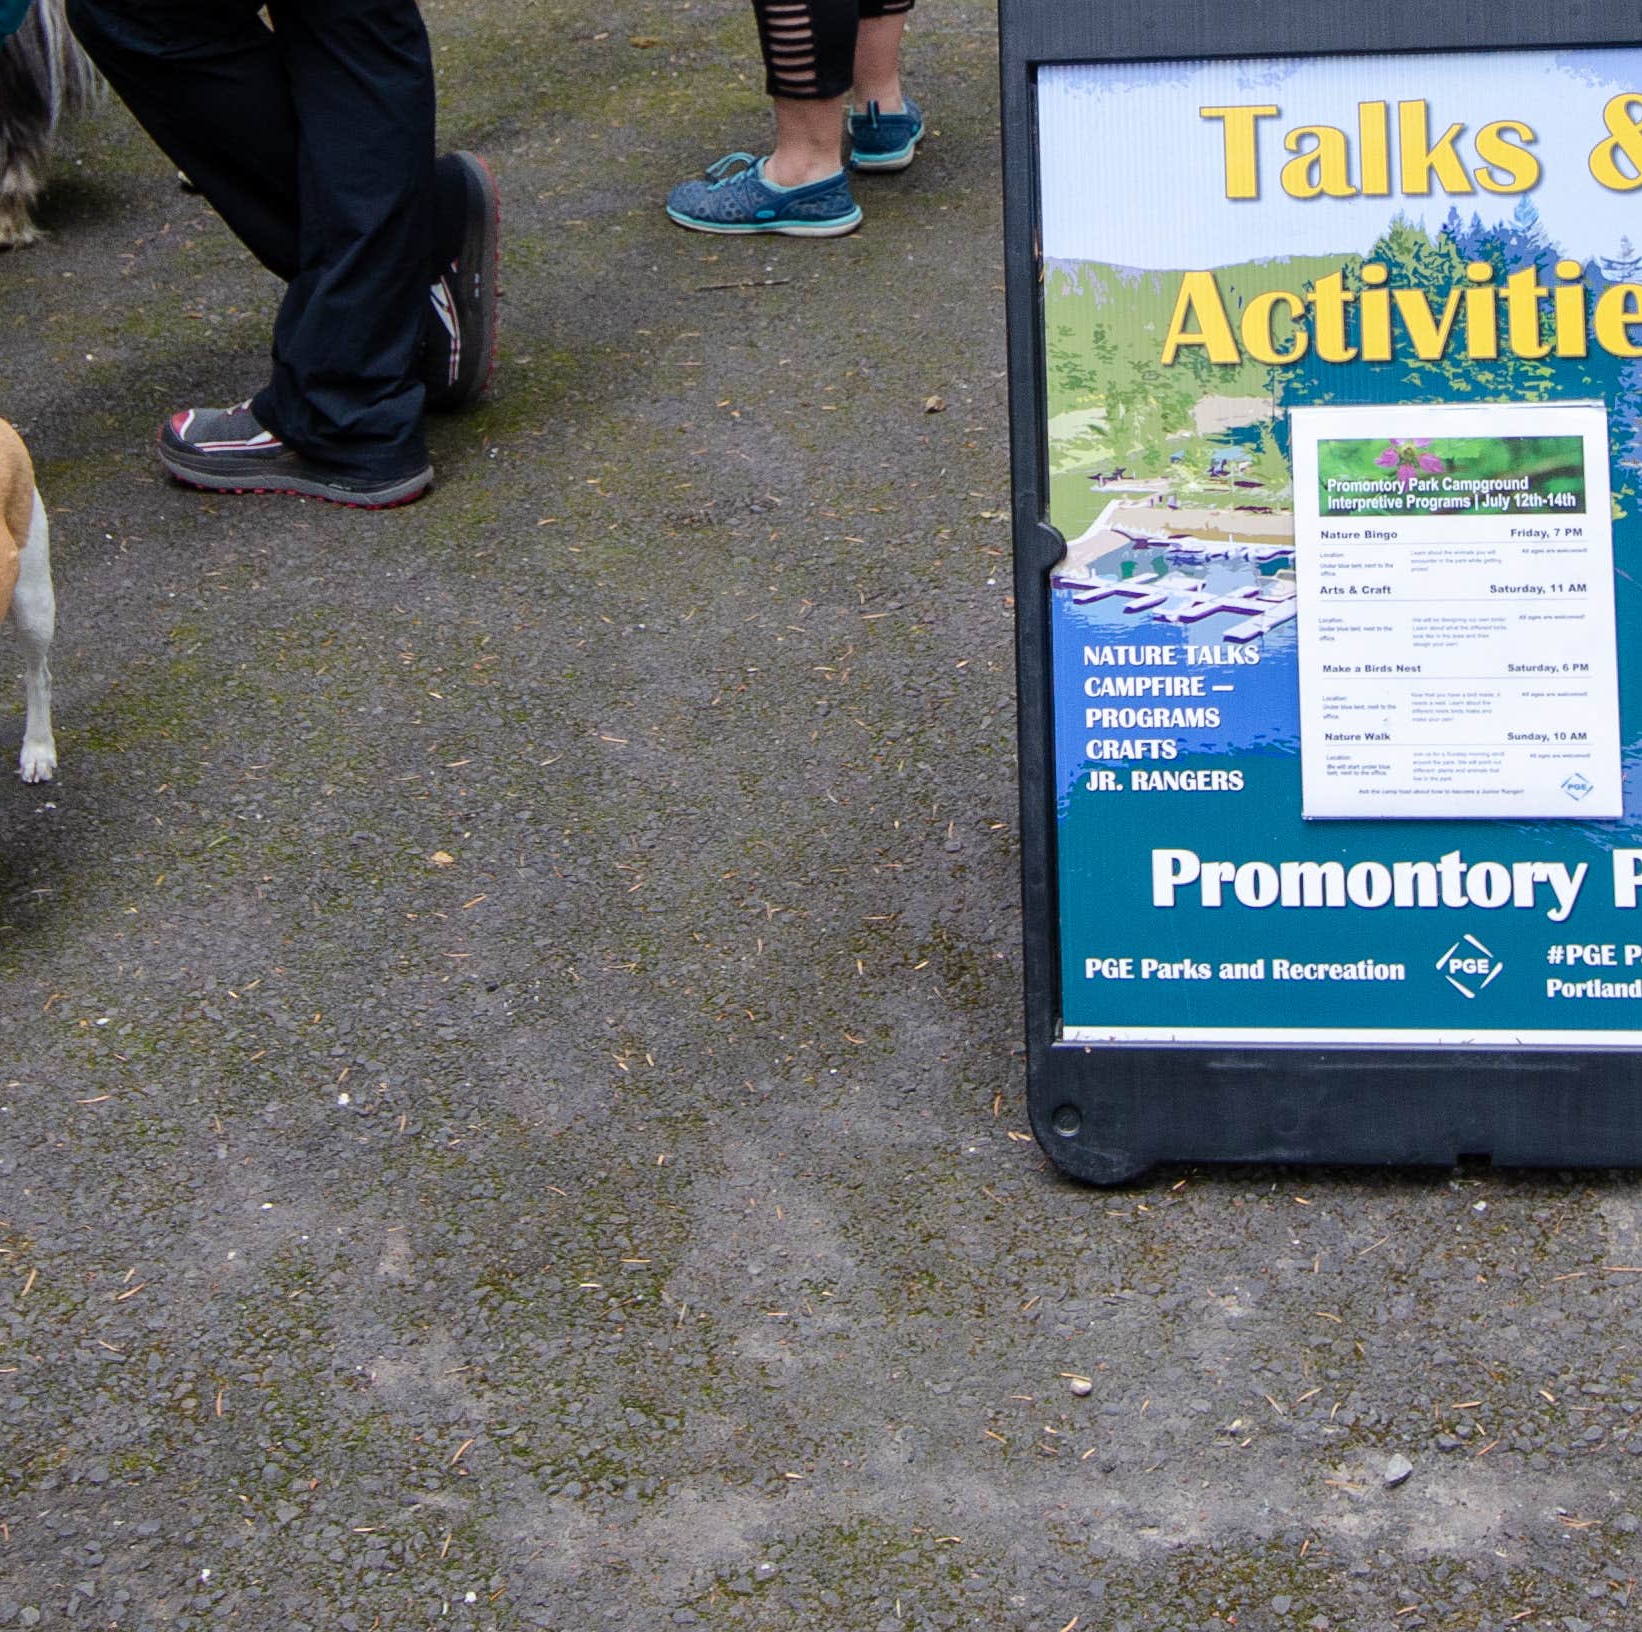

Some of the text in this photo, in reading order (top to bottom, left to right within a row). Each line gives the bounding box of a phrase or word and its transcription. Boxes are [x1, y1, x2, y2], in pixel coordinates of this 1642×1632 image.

[1199, 98, 1542, 200] Talks
[1327, 475, 1529, 494] Promontory Park Campground
[1328, 493, 1403, 510] Interpretive
[1406, 493, 1471, 511] Programs
[1482, 493, 1510, 510] July
[1513, 492, 1577, 508] 12th-14th
[1320, 530, 1398, 541] Nature Bingo
[1510, 527, 1583, 540] Friday, 7 PM
[1319, 585, 1392, 595] Arts & Craft
[1489, 583, 1587, 595] Saturday, 11 AM
[1084, 645, 1260, 666] NATURE TALKS
[1322, 664, 1352, 673] Make
[1364, 664, 1393, 673] Birds
[1396, 664, 1422, 673] Nest
[1507, 663, 1589, 674] Saturday, 6 PM
[1084, 676, 1206, 697] CAMPFIRE
[1085, 707, 1221, 729] PROGRAMS
[1324, 732, 1391, 741] Nature Walk
[1507, 732, 1588, 743] Sunday, 10 AM
[1085, 738, 1178, 760] CRAFTS
[1085, 770, 1245, 792] JR. RANGERS
[1566, 782, 1588, 792] PGE
[1150, 848, 1590, 924] Promontory
[1547, 944, 1617, 968] #PGE
[1085, 957, 1406, 982] PGE Parks and Recreation
[1449, 958, 1489, 976] PGE
